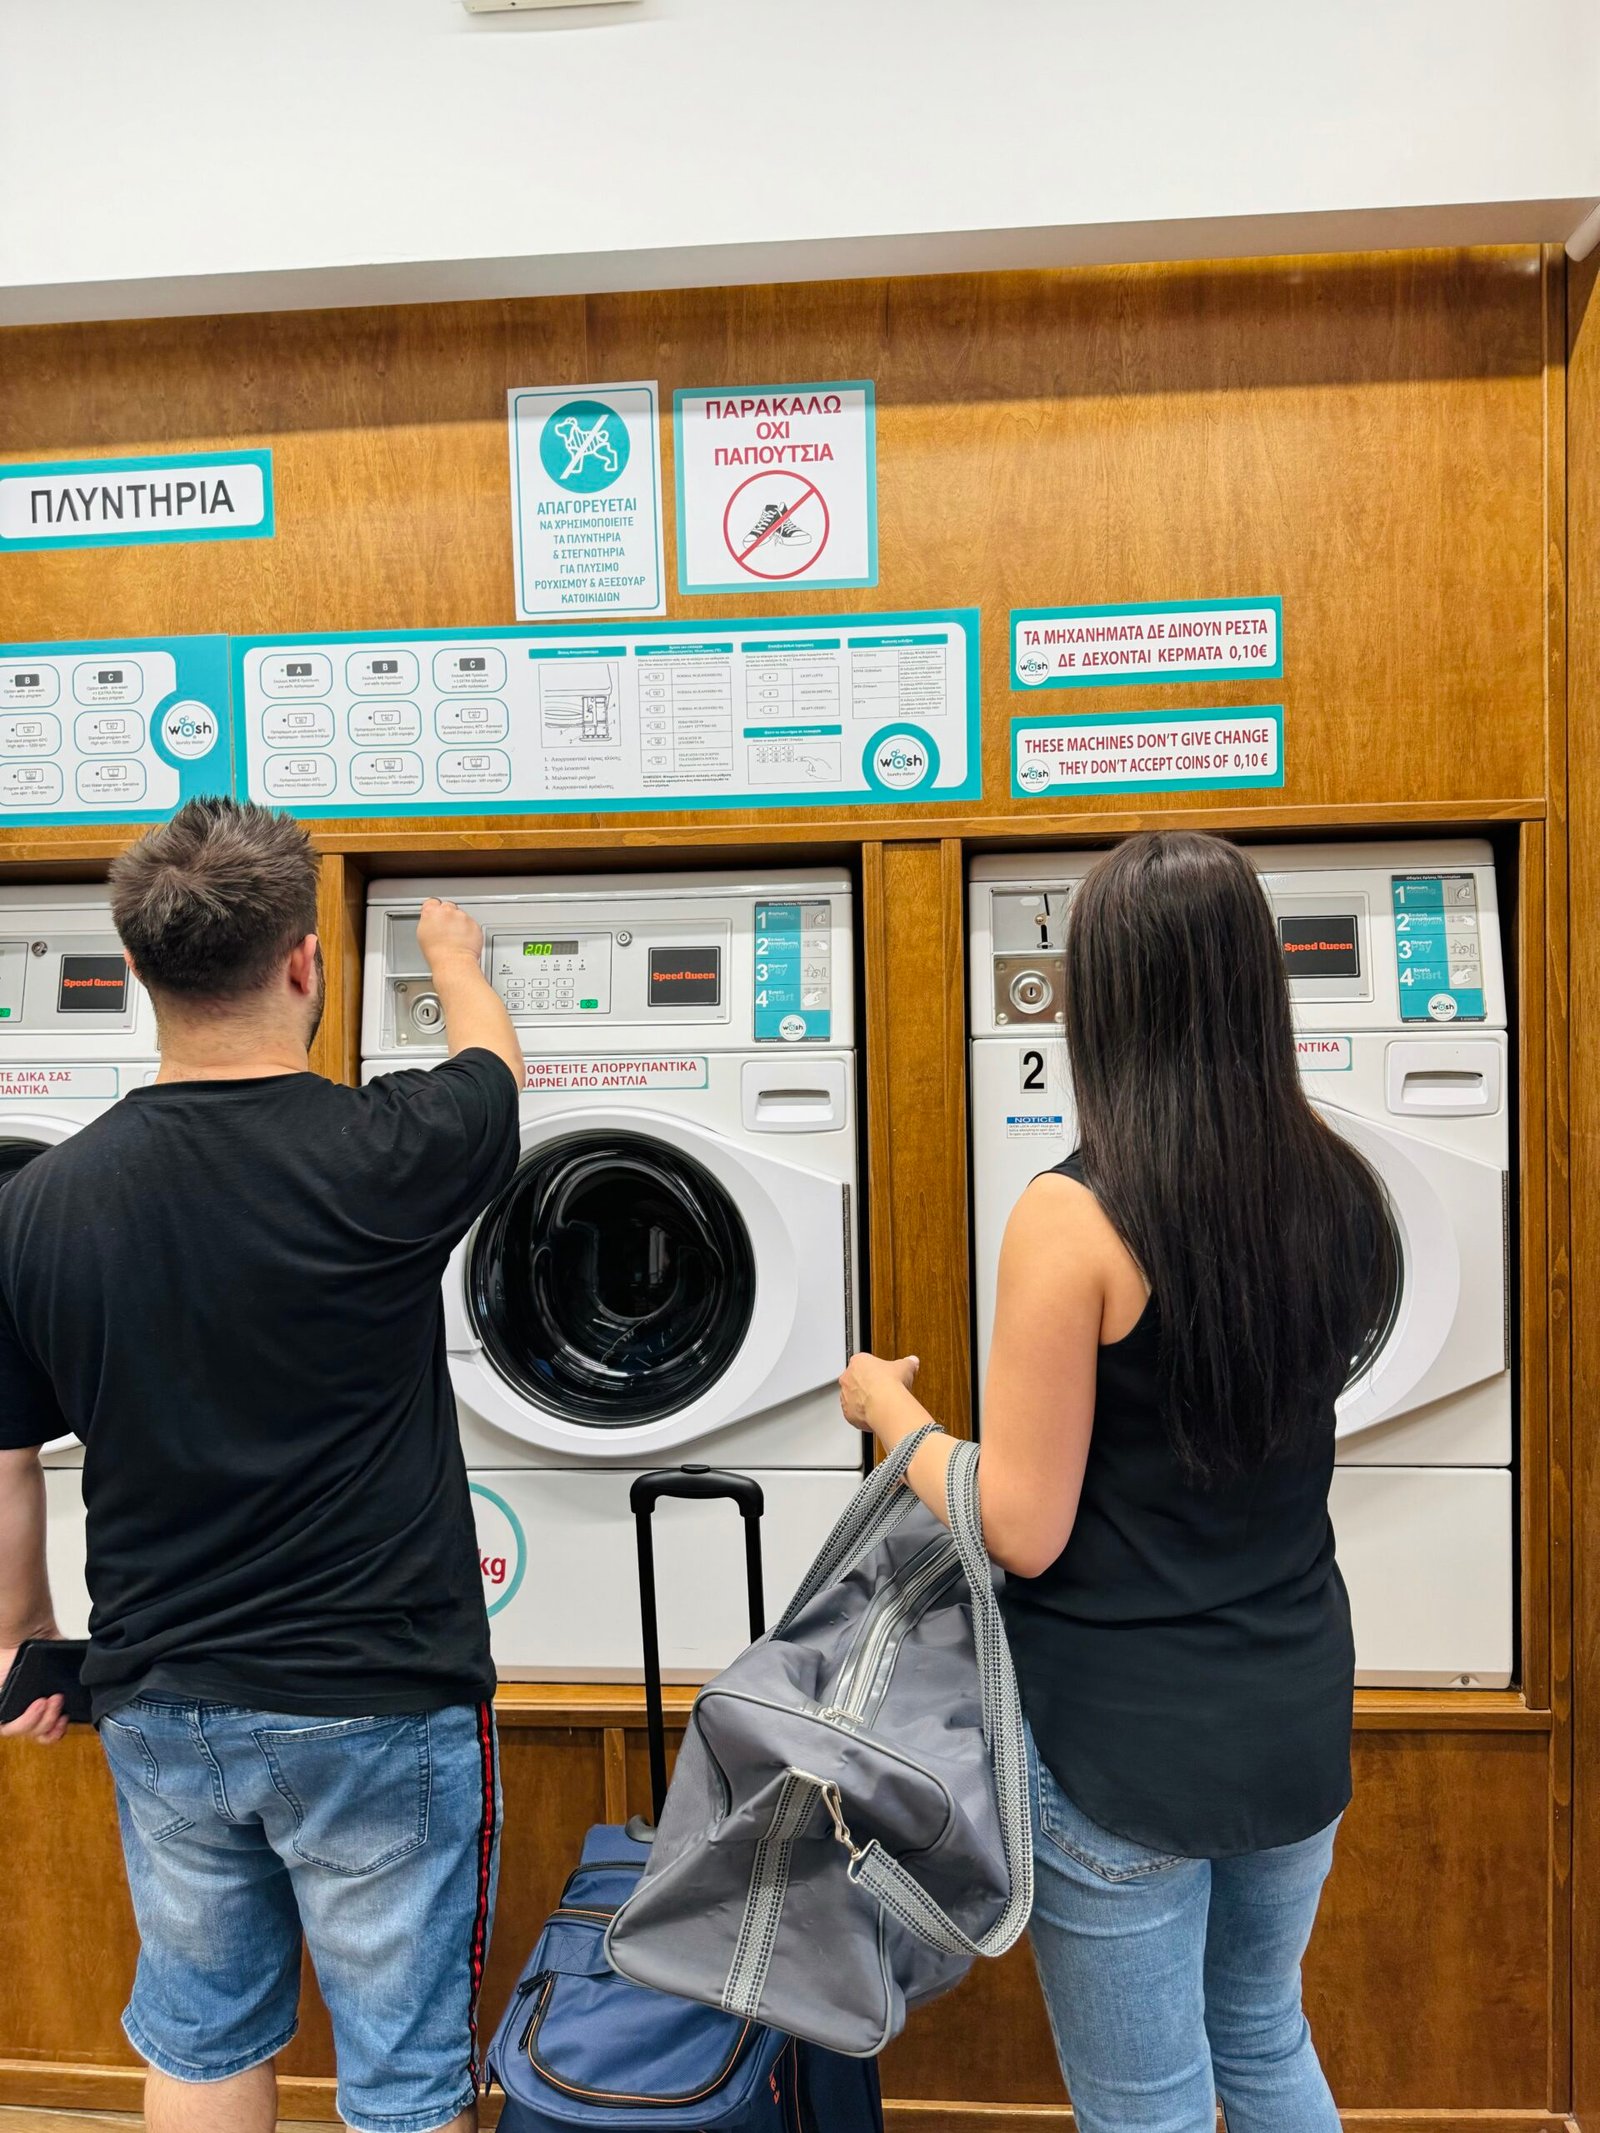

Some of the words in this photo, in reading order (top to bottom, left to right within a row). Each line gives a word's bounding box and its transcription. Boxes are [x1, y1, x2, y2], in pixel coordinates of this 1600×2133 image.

[705, 395, 842, 420] ΠΑΡΑΚΑΛΩ
[756, 421, 790, 440] ΟΧΙ
[714, 443, 834, 466] ΠΑΠΟΥΤΣΙΑ
[30, 479, 235, 524] ΠΛΥΝΤΗΡΙΑ
[536, 498, 638, 516] ΑΠΑΓΟΡΕΥΕΤΑΙ
[540, 519, 553, 530] ΝΑ
[555, 517, 634, 529] ΧΡΗΣΙΜΟΠΟΙΕΙΤΕ
[553, 534, 565, 544] ΤΑ
[566, 532, 621, 543] ΠΛΥΝΤΗΡΙΑ
[553, 548, 560, 559] &
[561, 546, 625, 558] ΣΤΕΓΝΩΤΗΡΙΑ
[560, 563, 575, 574] ΓΙΑ
[577, 562, 619, 573] ΠΛΥΣΙΜΟ
[535, 578, 588, 589] ΡΟΥΧΙΣΜΟΥ
[590, 577, 596, 588] &
[598, 576, 646, 588] ΑΞΕΣΟΥΑΡ
[561, 592, 620, 603] ΚΑΤΟΙΚΙΔΙΩΝ
[1024, 630, 1040, 645] ΤΑ
[1044, 625, 1144, 645] ΜΗΧΑΝΗΜΑΤΑ
[1147, 624, 1165, 639] ΔΕ
[1168, 621, 1221, 638] ΔΙΝΟΥΝ
[1226, 619, 1268, 635] ΡΕΣΤΑ
[1058, 653, 1075, 667] ΔΕ
[1082, 649, 1151, 666] ΔΕΧΟΝΤΑΙ
[1158, 646, 1222, 662] ΚΕΡΜΑΤΑ
[1229, 644, 1267, 661] 0,10€
[296, 666, 302, 674] A
[382, 663, 389, 671] B
[470, 660, 476, 668] C
[108, 673, 114, 681] C
[168, 721, 212, 737] wash
[1025, 737, 1064, 753] THESE
[1067, 735, 1134, 752] MACHINES
[1137, 733, 1178, 749] DON’T
[1181, 731, 1211, 746] GIVE
[1214, 729, 1269, 745] CHANGE
[880, 754, 922, 769] wash
[1059, 761, 1088, 775] THEY
[1091, 759, 1127, 774] DON’T
[1130, 757, 1173, 772] ACCEPT
[1176, 755, 1210, 770] COINS
[1213, 754, 1228, 768] OF
[1234, 753, 1258, 770] 0,10
[1261, 753, 1268, 766] €
[1395, 885, 1405, 904] 1
[757, 911, 766, 929] 1
[1396, 913, 1411, 932] 2
[756, 937, 769, 955] 2
[1284, 942, 1317, 952] Speed
[1319, 941, 1353, 951] Queen
[1398, 940, 1412, 959] 3
[1411, 943, 1433, 953] Pay
[653, 972, 683, 982] Speed
[684, 971, 715, 980] Queen
[756, 964, 769, 982] 3
[768, 967, 788, 976] Pay
[1400, 968, 1415, 986] 4
[1413, 971, 1442, 980] Start
[64, 979, 93, 988] Speed
[94, 978, 124, 987] Queen
[756, 990, 769, 1008] 4
[768, 993, 794, 1002] Start
[1298, 1041, 1340, 1052] ΝΤΙΚΑ
[527, 1064, 588, 1074] ΟΘΕΤΕΙΤΕ
[592, 1061, 697, 1073] ΑΠΟΡΡΥΠΑΝΤΙΚΑ
[1022, 1051, 1045, 1090] 2
[17, 1072, 45, 1081] ΔΙΚΑ
[49, 1072, 72, 1081] ΣΑΣ
[524, 1077, 567, 1088] ΑΙΡΝΕΙ
[571, 1076, 598, 1087] ΑΠΟ
[602, 1075, 647, 1086] ΑΝΤΛΙΑ
